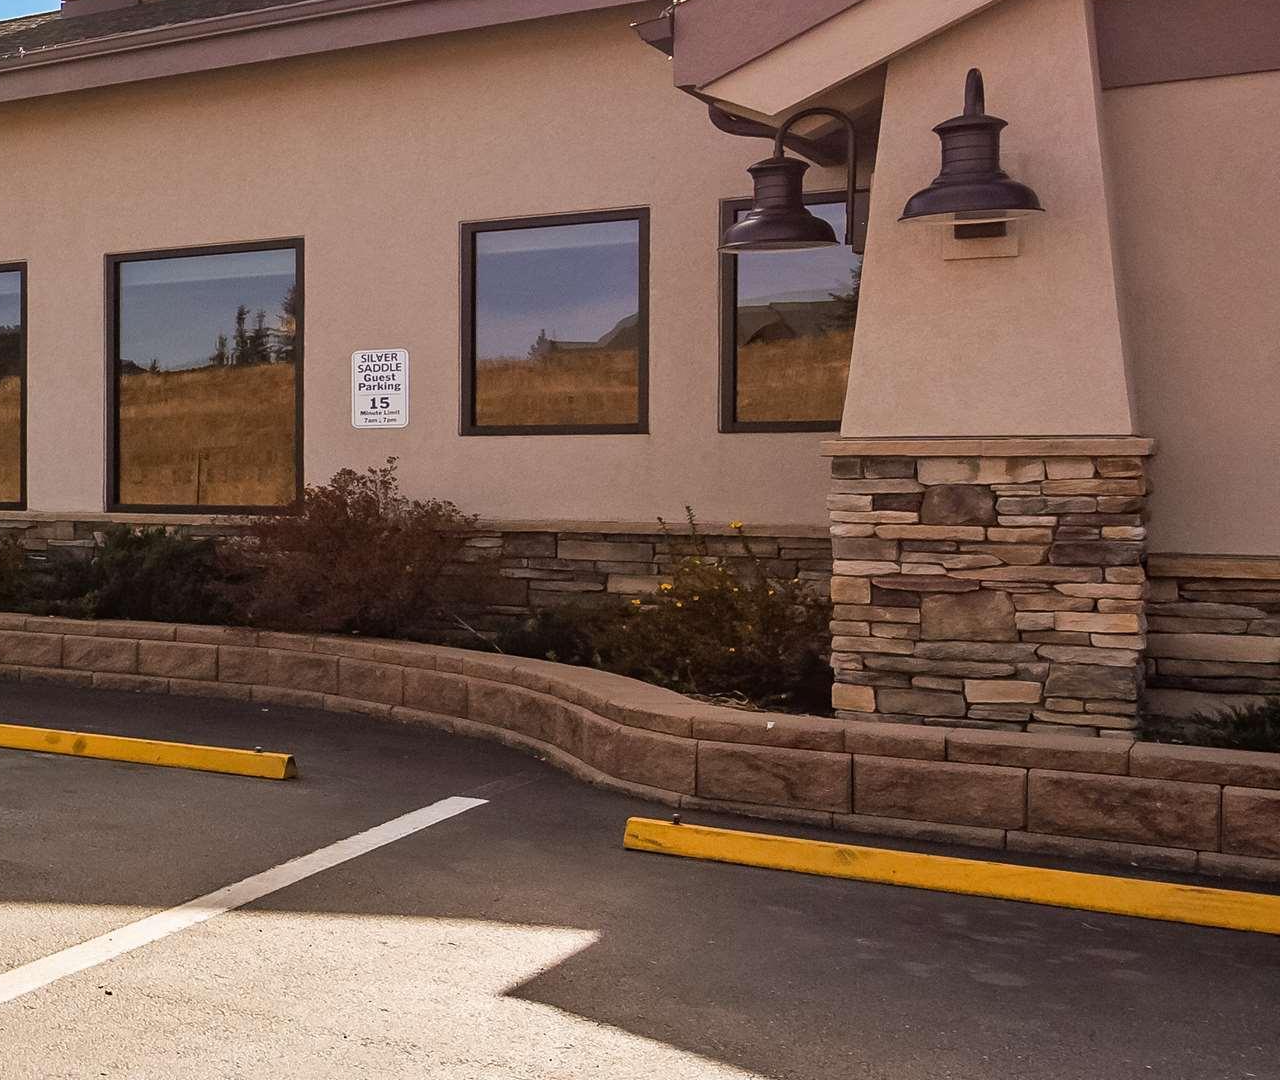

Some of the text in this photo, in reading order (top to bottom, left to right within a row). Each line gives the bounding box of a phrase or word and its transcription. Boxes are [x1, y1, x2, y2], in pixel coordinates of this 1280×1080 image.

[361, 353, 398, 363] SILVER
[358, 363, 402, 373] SADDLE
[364, 373, 396, 382] Guest
[358, 382, 401, 391] Parking
[370, 397, 390, 409] 15
